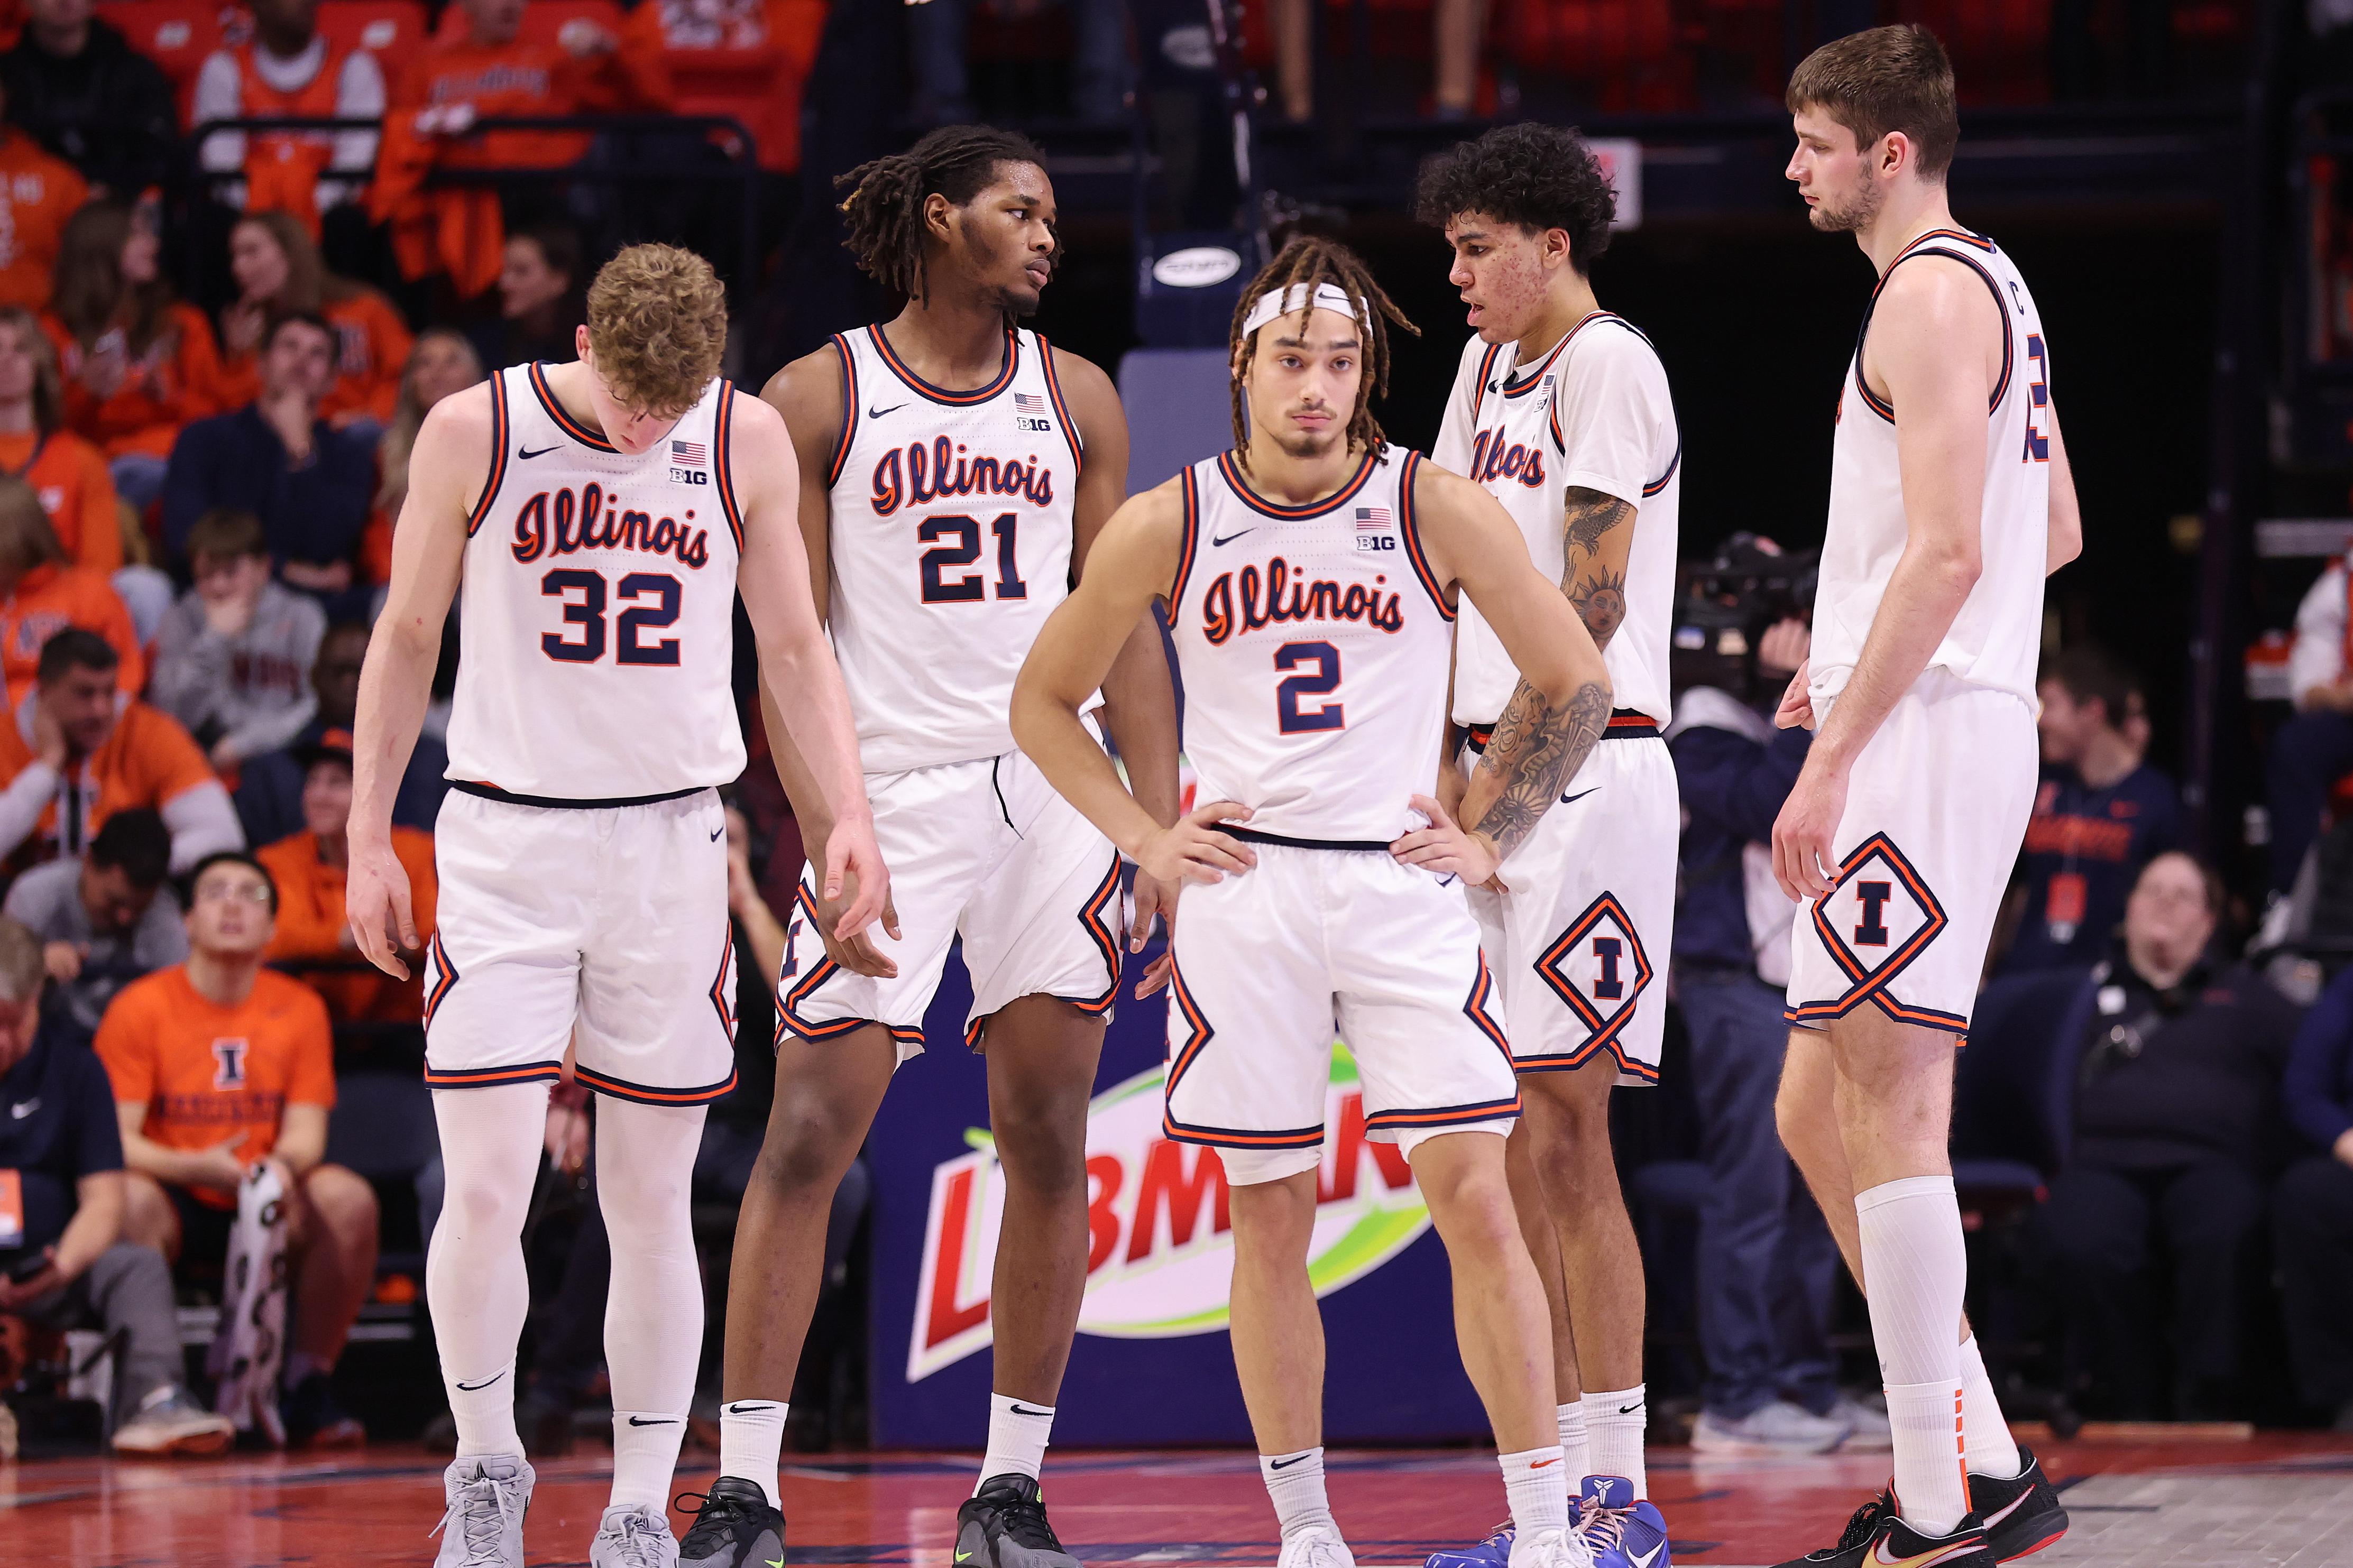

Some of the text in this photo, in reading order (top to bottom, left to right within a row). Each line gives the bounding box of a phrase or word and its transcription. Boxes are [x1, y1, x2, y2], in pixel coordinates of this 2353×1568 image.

[870, 435, 1053, 516] Illinois
[511, 482, 709, 569] Illinois
[917, 513, 1027, 604] 21
[541, 568, 682, 667] 32
[1202, 556, 1404, 647] Illinois
[1273, 640, 1345, 735] 2
[1854, 880, 1892, 947] I
[1592, 937, 1623, 1001] I
[926, 1091, 1414, 1350] LBMN
